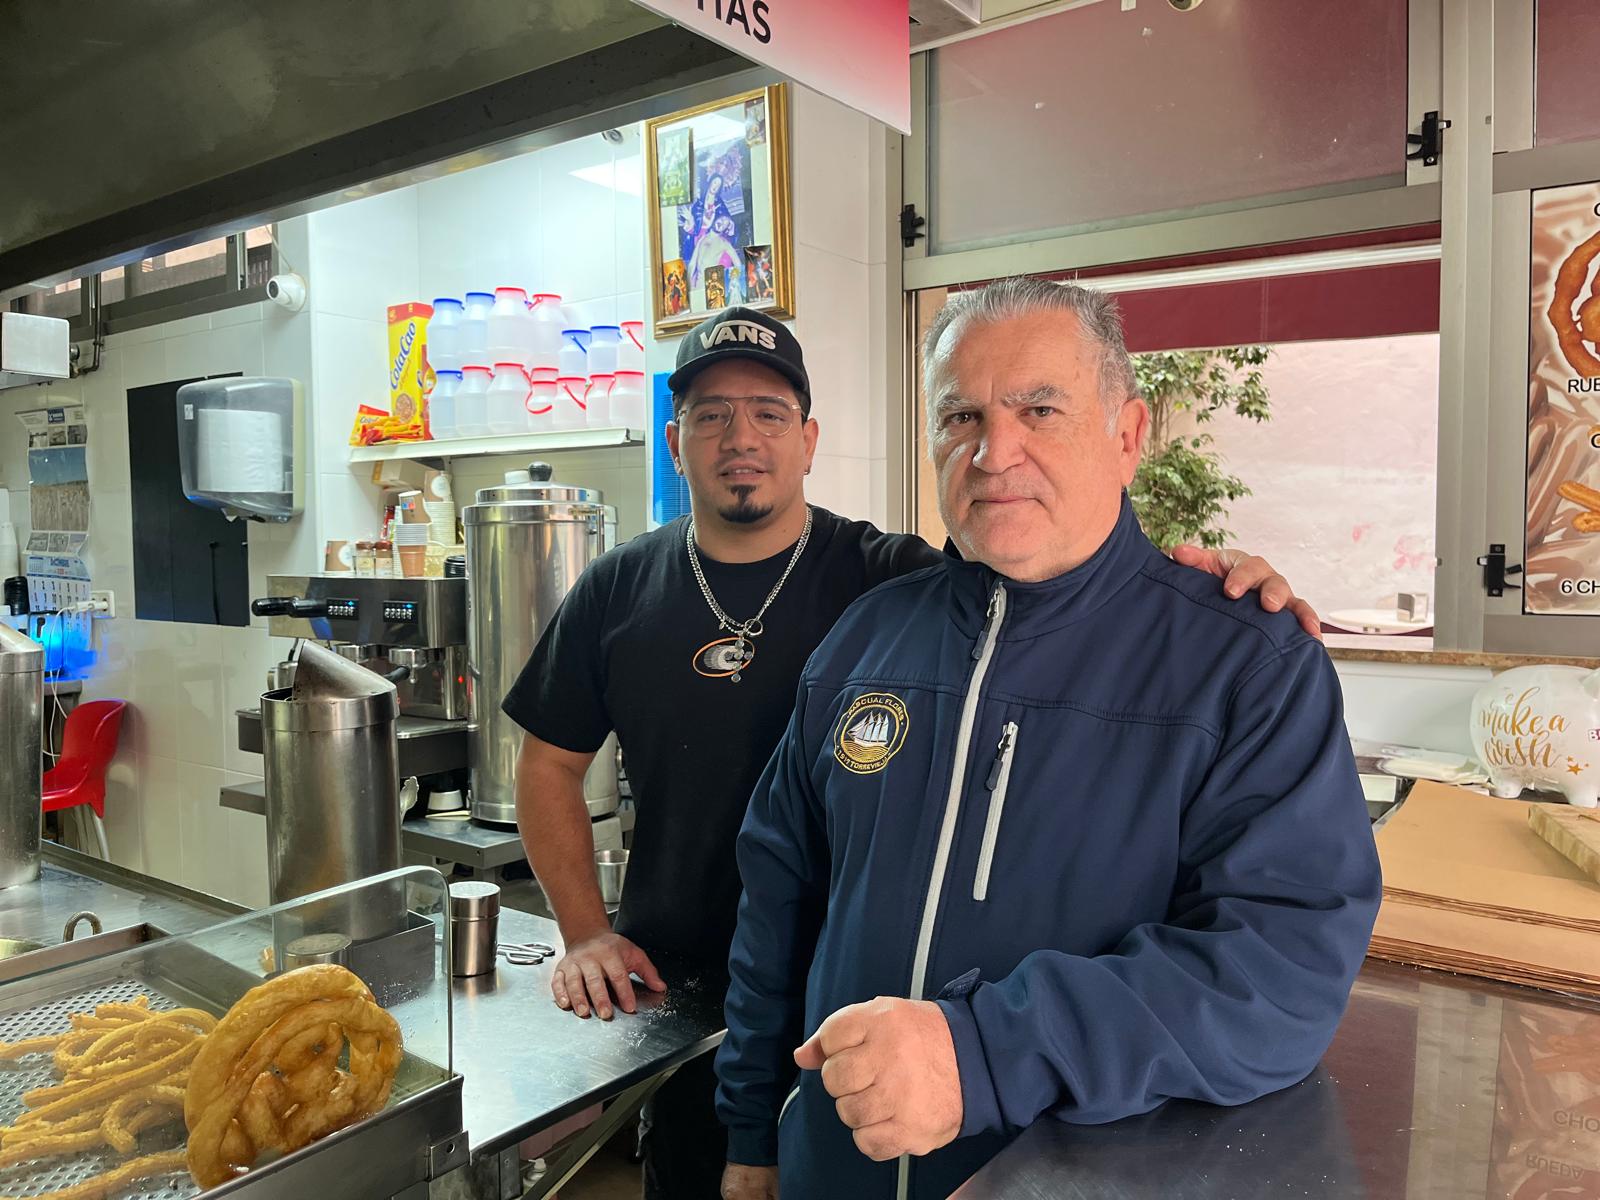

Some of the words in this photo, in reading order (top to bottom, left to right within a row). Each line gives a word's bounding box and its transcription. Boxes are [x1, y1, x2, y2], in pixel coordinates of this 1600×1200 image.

[697, 0, 771, 44] AS
[700, 319, 777, 350] VANS
[1561, 580, 1573, 594] 6
[1479, 686, 1544, 737] make
[1547, 714, 1571, 733] a
[1484, 730, 1563, 768] wish
